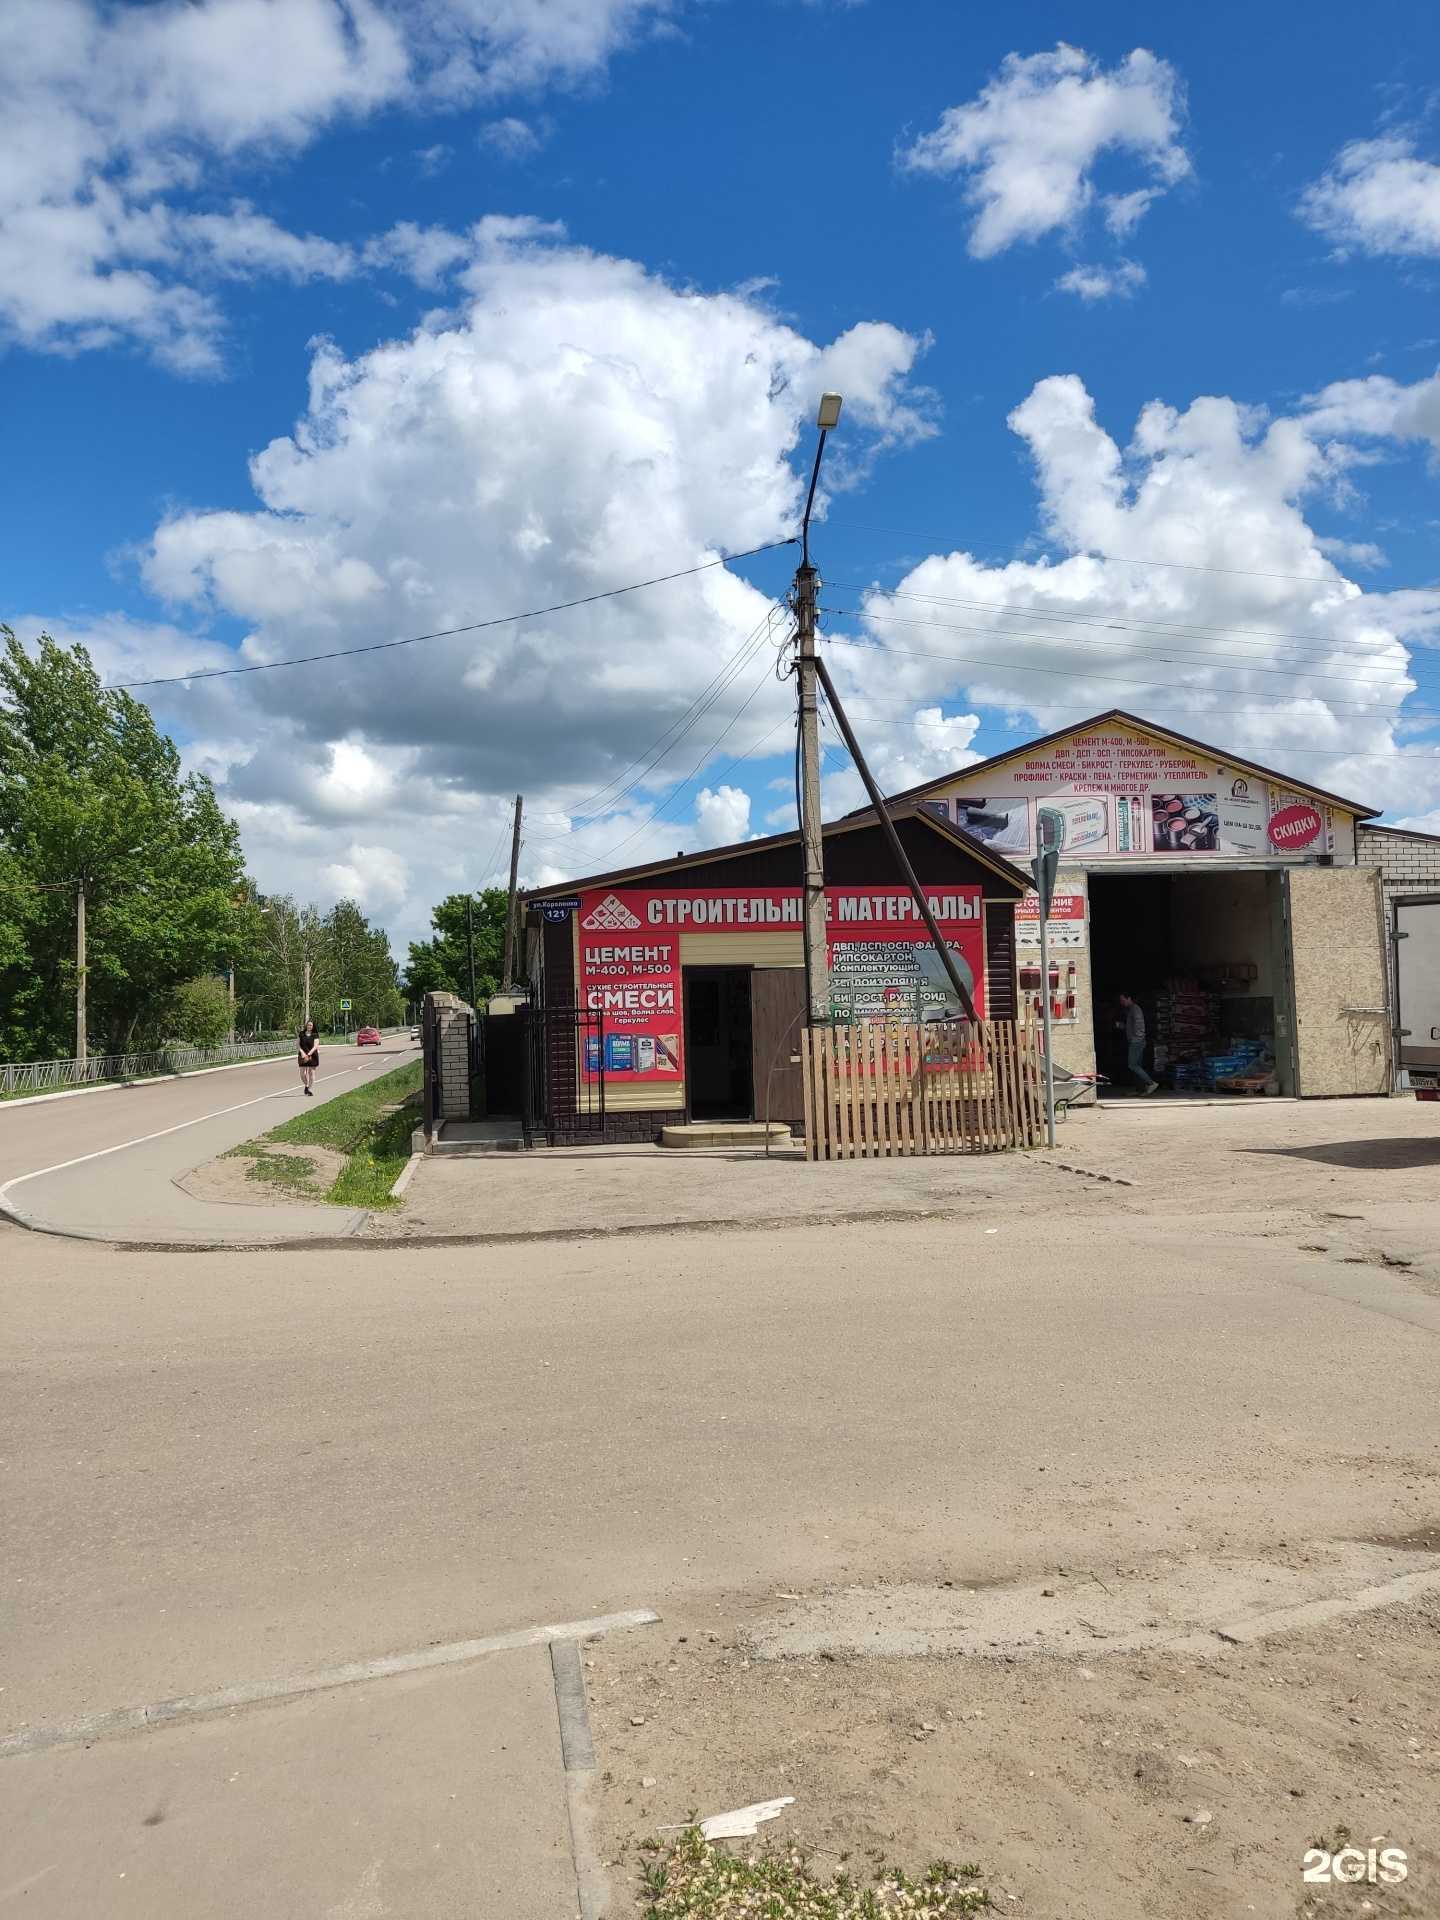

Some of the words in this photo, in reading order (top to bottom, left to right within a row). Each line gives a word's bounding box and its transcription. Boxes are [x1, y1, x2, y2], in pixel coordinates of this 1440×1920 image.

[1072, 737, 1100, 747] ЦЕМЕНТ
[1102, 737, 1125, 746] М-400,
[1055, 750, 1070, 759] ДВП
[1076, 750, 1091, 758] ДСП
[1097, 750, 1111, 758] ОСП
[1116, 749, 1166, 757] ГИПСОКАРТОН
[1025, 762, 1050, 770] ВОЛМА
[1051, 761, 1076, 769] СМЕСИ
[1081, 761, 1113, 769] БИКРОСТ
[1119, 760, 1154, 769] ГЕРКУЛЕС
[1159, 760, 1197, 769] РУБЕРОИД
[1014, 773, 1053, 782] ПРОФЛИСТ
[1059, 773, 1087, 781] КРАСКИ
[1093, 773, 1111, 781] ПЕНА
[1117, 772, 1158, 780] ГЕРМЕТИКИ
[1163, 771, 1209, 780] УТЕПЛИТЕЛЬ
[1074, 784, 1104, 793] КРЕПЕЖ
[1110, 783, 1139, 792] МНОГОЕ
[1273, 815, 1317, 840] СКИДКИ
[547, 909, 565, 918] 121
[647, 897, 833, 925] СТРОИТЕЛЬНЕ
[832, 943, 857, 952] ДВП,
[859, 942, 885, 951] ДСП,
[887, 942, 913, 951] ОСП,
[915, 941, 964, 950] ФАРА,
[585, 945, 672, 965] ЦЕМЕНТ
[832, 953, 916, 963] ГИПСОКАРТОН,
[585, 965, 629, 976] М-400,
[632, 964, 672, 974] М-500
[833, 964, 920, 973] Комплектующие
[613, 982, 674, 990] СТРОИТЕЛЬНЫЕ
[587, 990, 674, 1009] СМЕСИ
[834, 994, 887, 1003] БИРОСТ,
[614, 1017, 649, 1025] Геркулес
